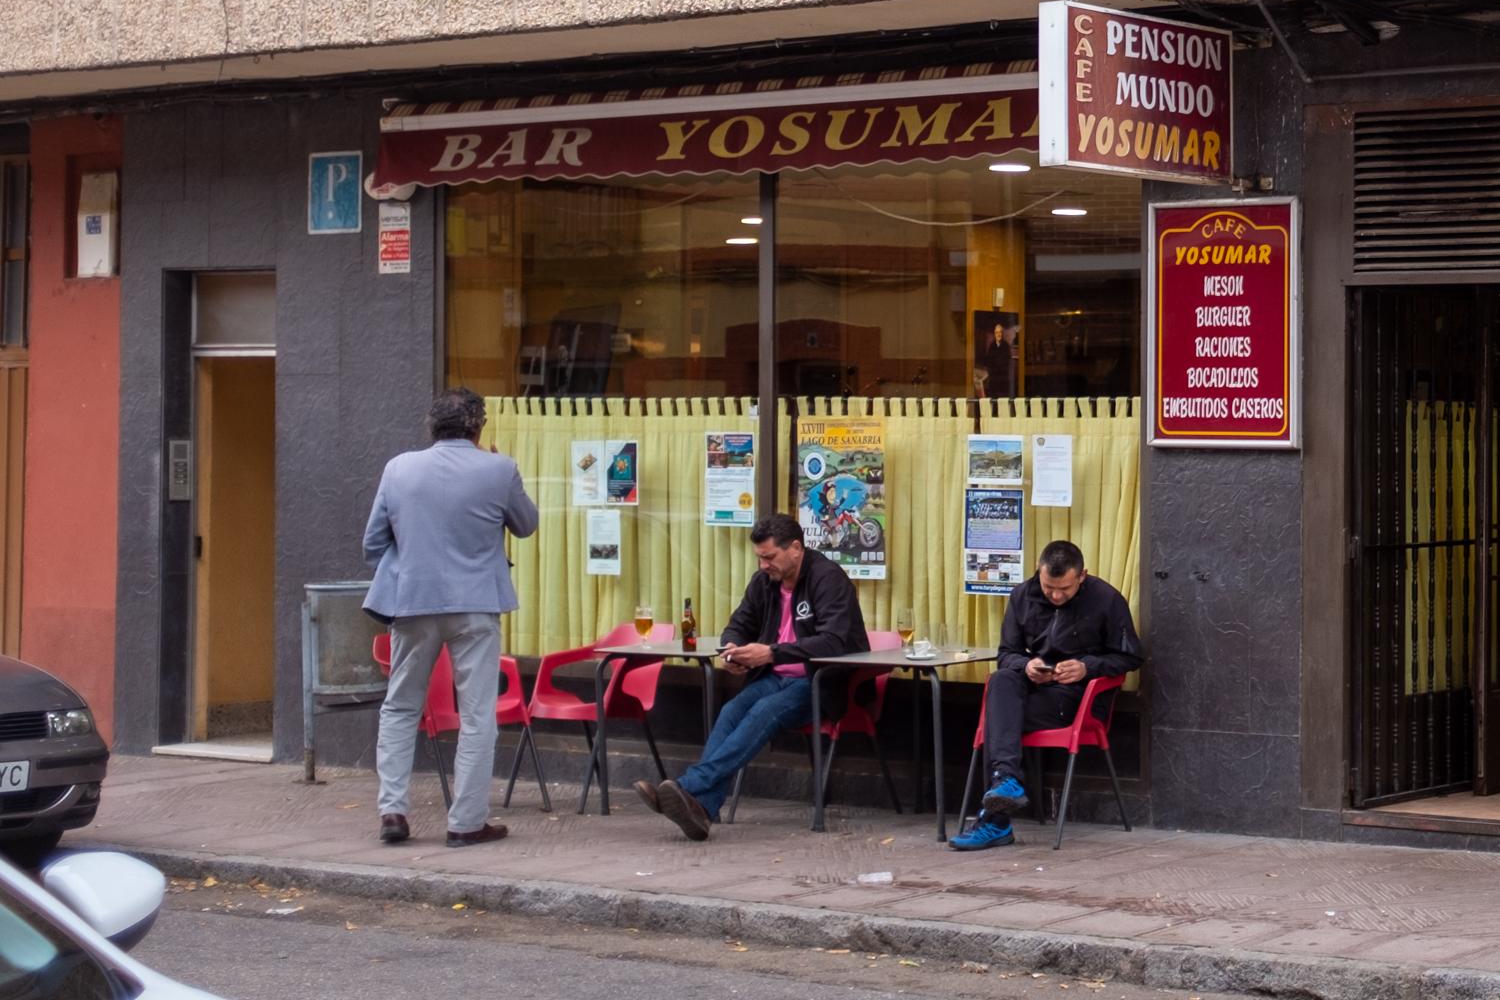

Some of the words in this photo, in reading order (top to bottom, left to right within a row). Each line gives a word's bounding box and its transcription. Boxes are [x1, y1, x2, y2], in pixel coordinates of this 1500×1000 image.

[1106, 20, 1222, 71] PENSION
[1074, 14, 1094, 102] CAFE
[1115, 72, 1214, 117] MUNDO
[430, 127, 592, 172] BAR
[656, 97, 1039, 161] YOSUMA
[1078, 113, 1221, 170] YOSUMAR
[381, 232, 409, 241] Alarma
[1201, 218, 1247, 239] CAFE
[1175, 244, 1272, 265] YOSUMAR
[1203, 275, 1244, 297] MESON
[1195, 306, 1251, 328] BURGUER
[1195, 336, 1252, 358] RACIONES
[1186, 367, 1259, 388] BOCADILLOS
[1162, 397, 1228, 418] EMBUTIDOS
[1231, 397, 1284, 419] CASEROS
[801, 423, 825, 434] XXVIII
[801, 435, 825, 446] LAGO
[827, 436, 839, 445] DE
[841, 435, 881, 445] SANABRIA
